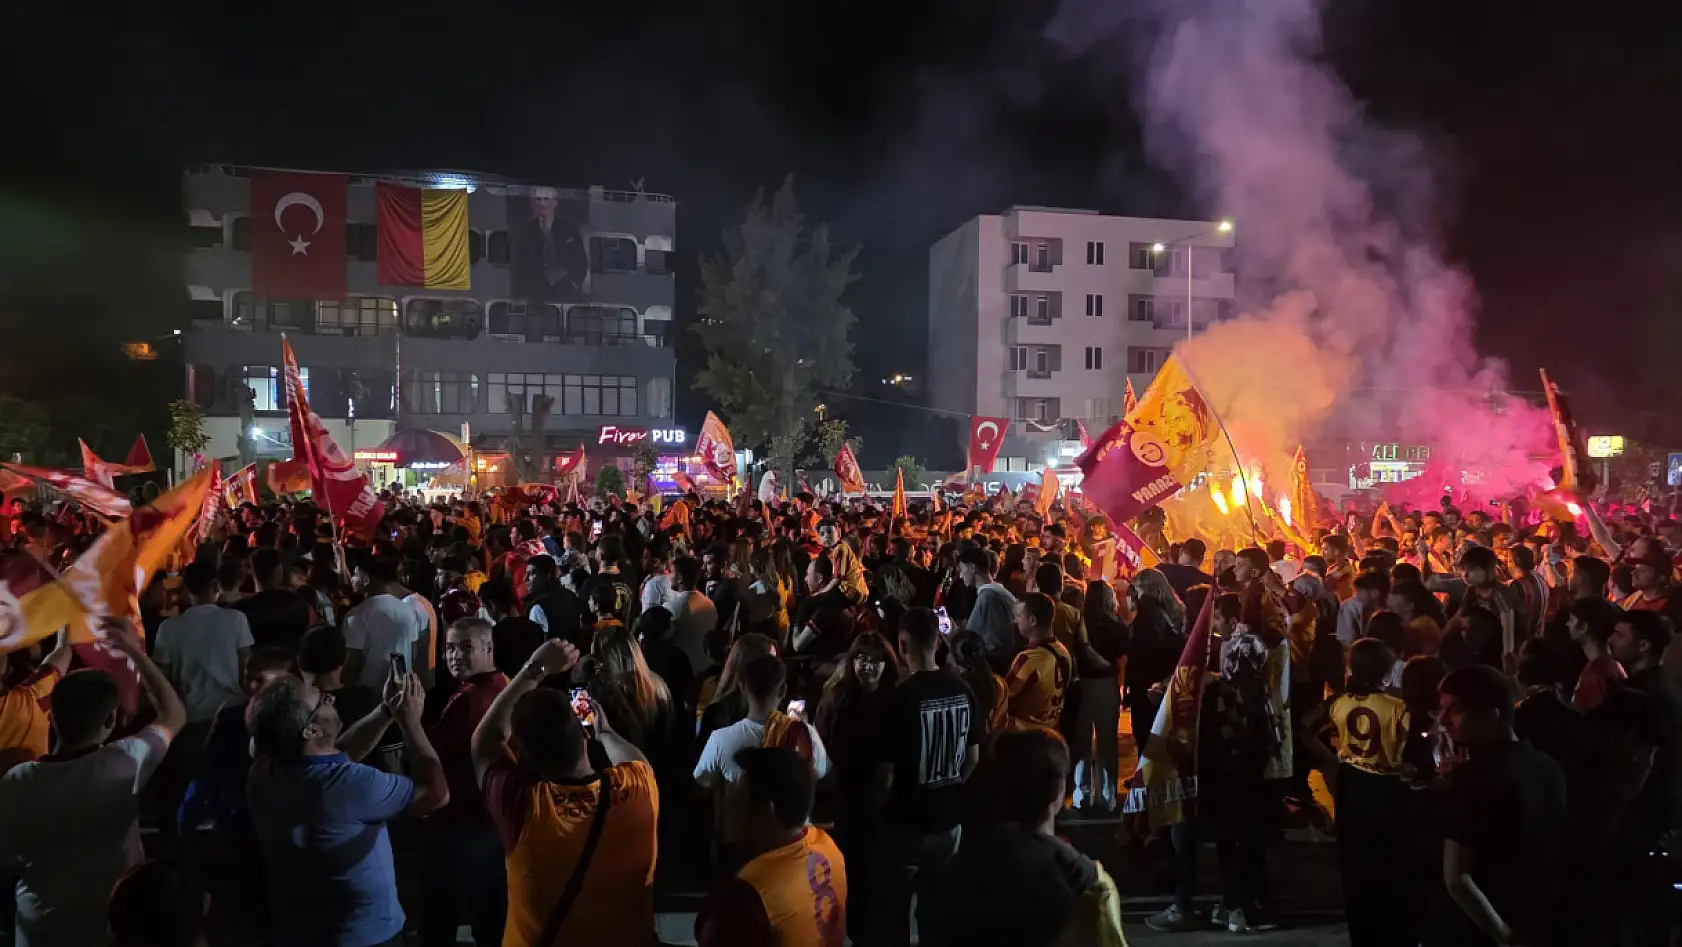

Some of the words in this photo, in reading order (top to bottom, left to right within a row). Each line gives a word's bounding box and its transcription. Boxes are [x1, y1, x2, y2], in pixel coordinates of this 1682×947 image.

[652, 428, 686, 443] PUB
[1346, 706, 1381, 758] 9
[806, 851, 838, 938] 8
